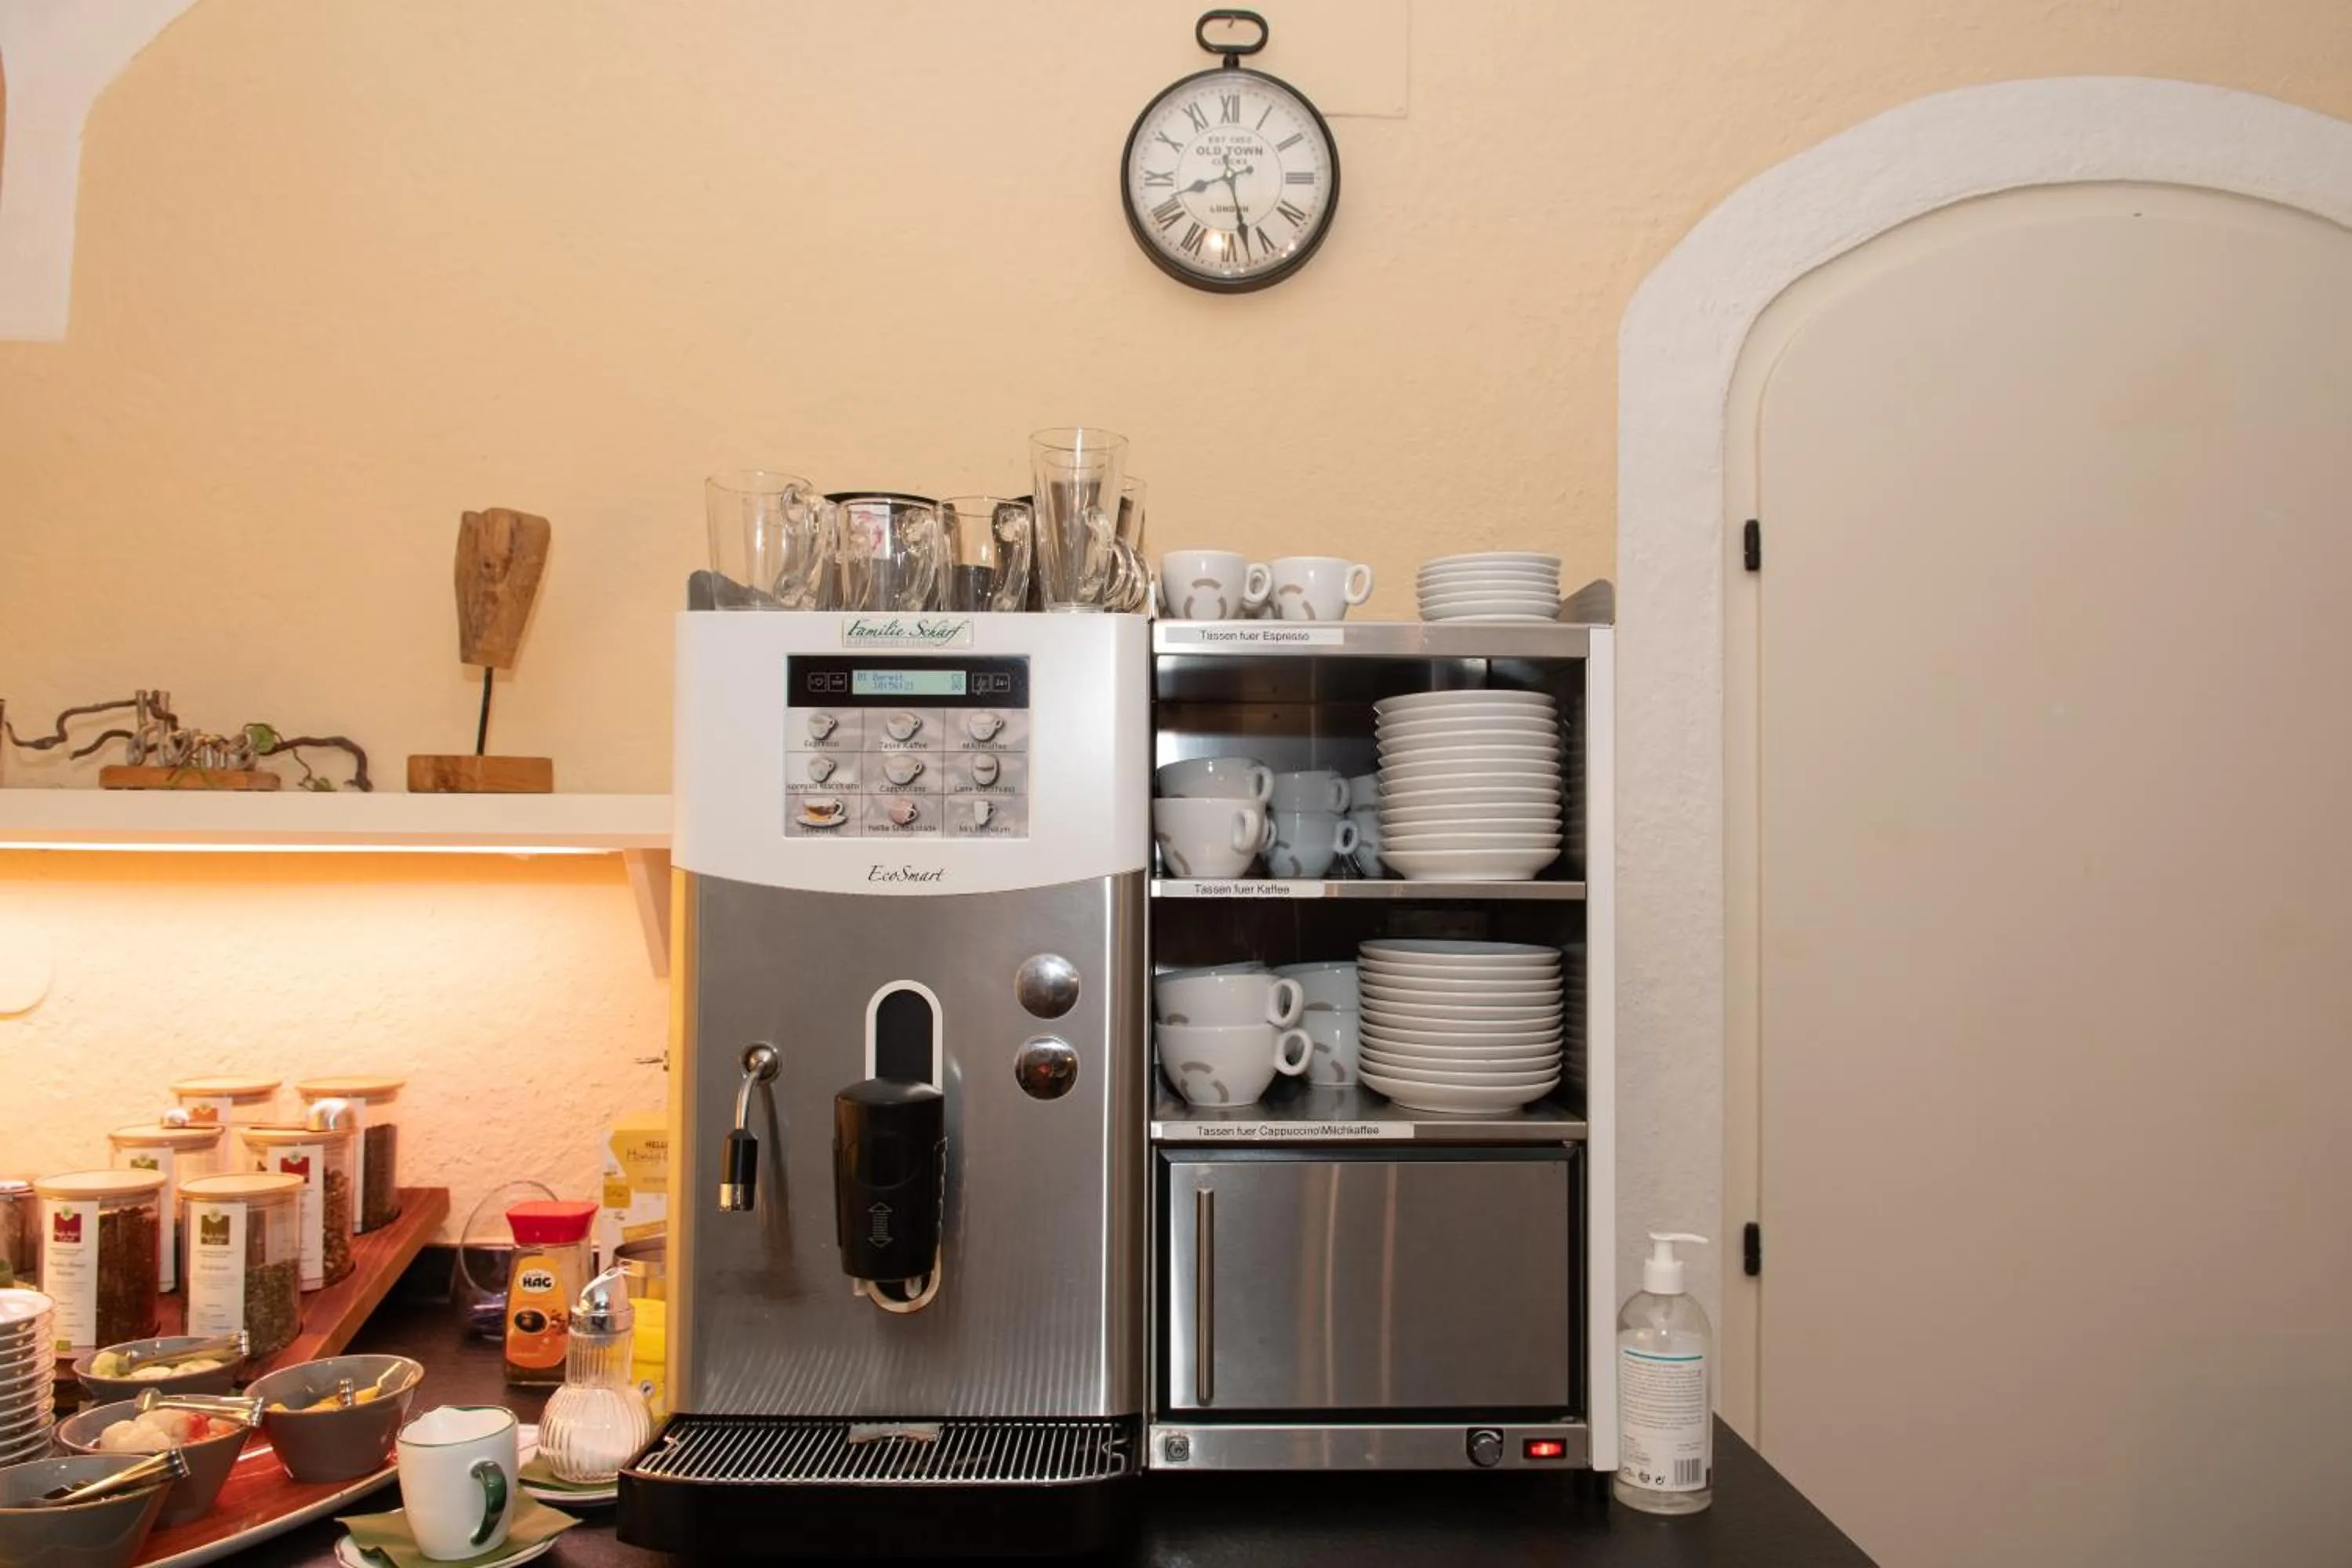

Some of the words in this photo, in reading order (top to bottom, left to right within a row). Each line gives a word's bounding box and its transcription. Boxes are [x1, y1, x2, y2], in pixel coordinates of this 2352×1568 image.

[1182, 101, 1209, 133] XI
[1220, 95, 1240, 123] XII
[1155, 131, 1184, 154] X
[1276, 132, 1304, 152] II
[1196, 146, 1221, 155] OLD
[1227, 146, 1263, 156] TOWN
[1145, 170, 1174, 186] IX
[1285, 172, 1314, 184] III
[1180, 222, 1207, 256] VII
[1256, 226, 1276, 254] V
[848, 619, 905, 637] Familie
[1200, 630, 1237, 641] Tassen
[1239, 630, 1259, 641] fuer
[1263, 630, 1310, 643] Espresso
[868, 865, 944, 882] EcoSmart
[1194, 884, 1232, 895] Tassen
[1234, 884, 1254, 895] fuer
[1257, 884, 1290, 895] Kaffee
[1196, 1126, 1235, 1136] Tassen
[1236, 1126, 1257, 1136] fuer
[523, 1277, 551, 1287] HAG
